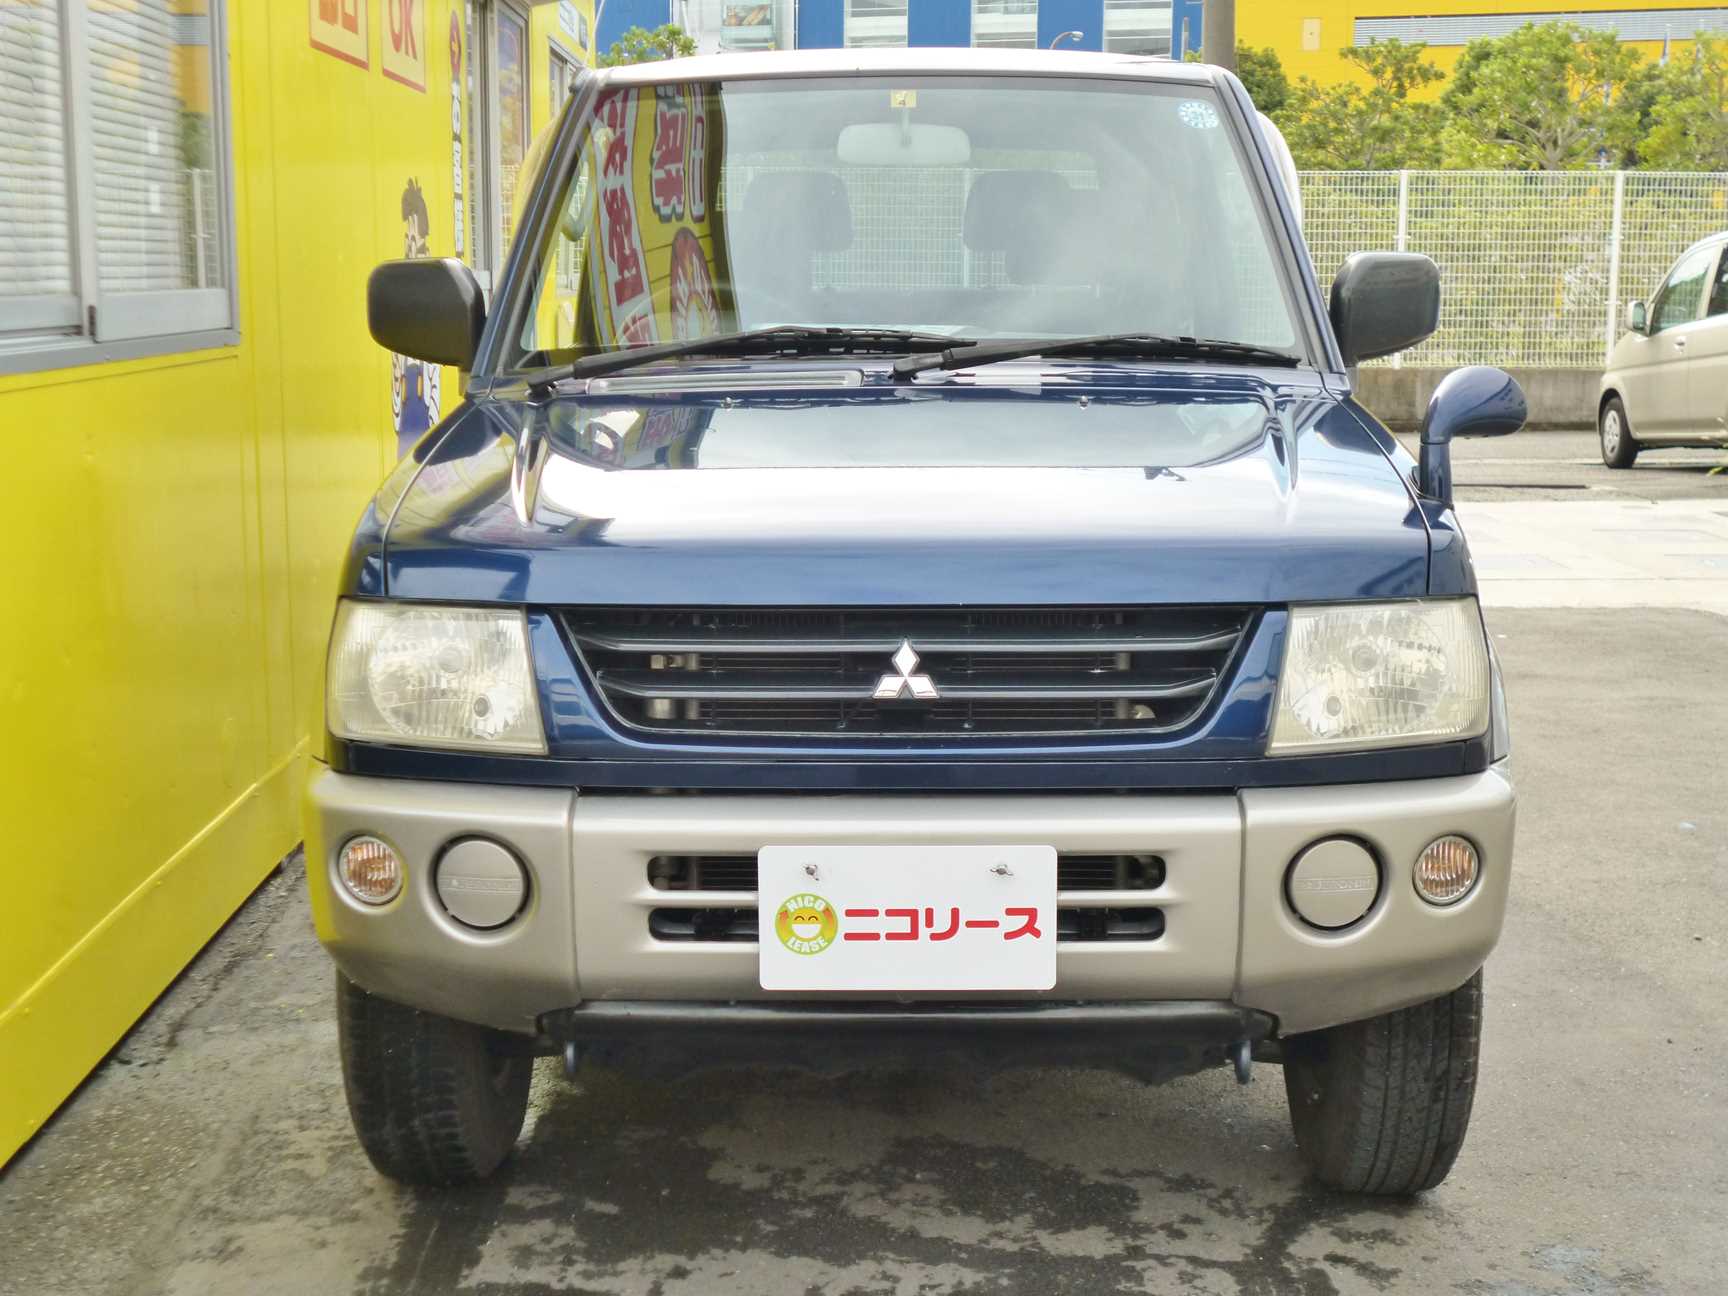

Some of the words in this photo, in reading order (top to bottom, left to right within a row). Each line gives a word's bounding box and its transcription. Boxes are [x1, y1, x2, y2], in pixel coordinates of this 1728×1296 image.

[786, 896, 826, 912] NICO
[844, 907, 1041, 941] ニコリース
[786, 935, 828, 953] LEASE
